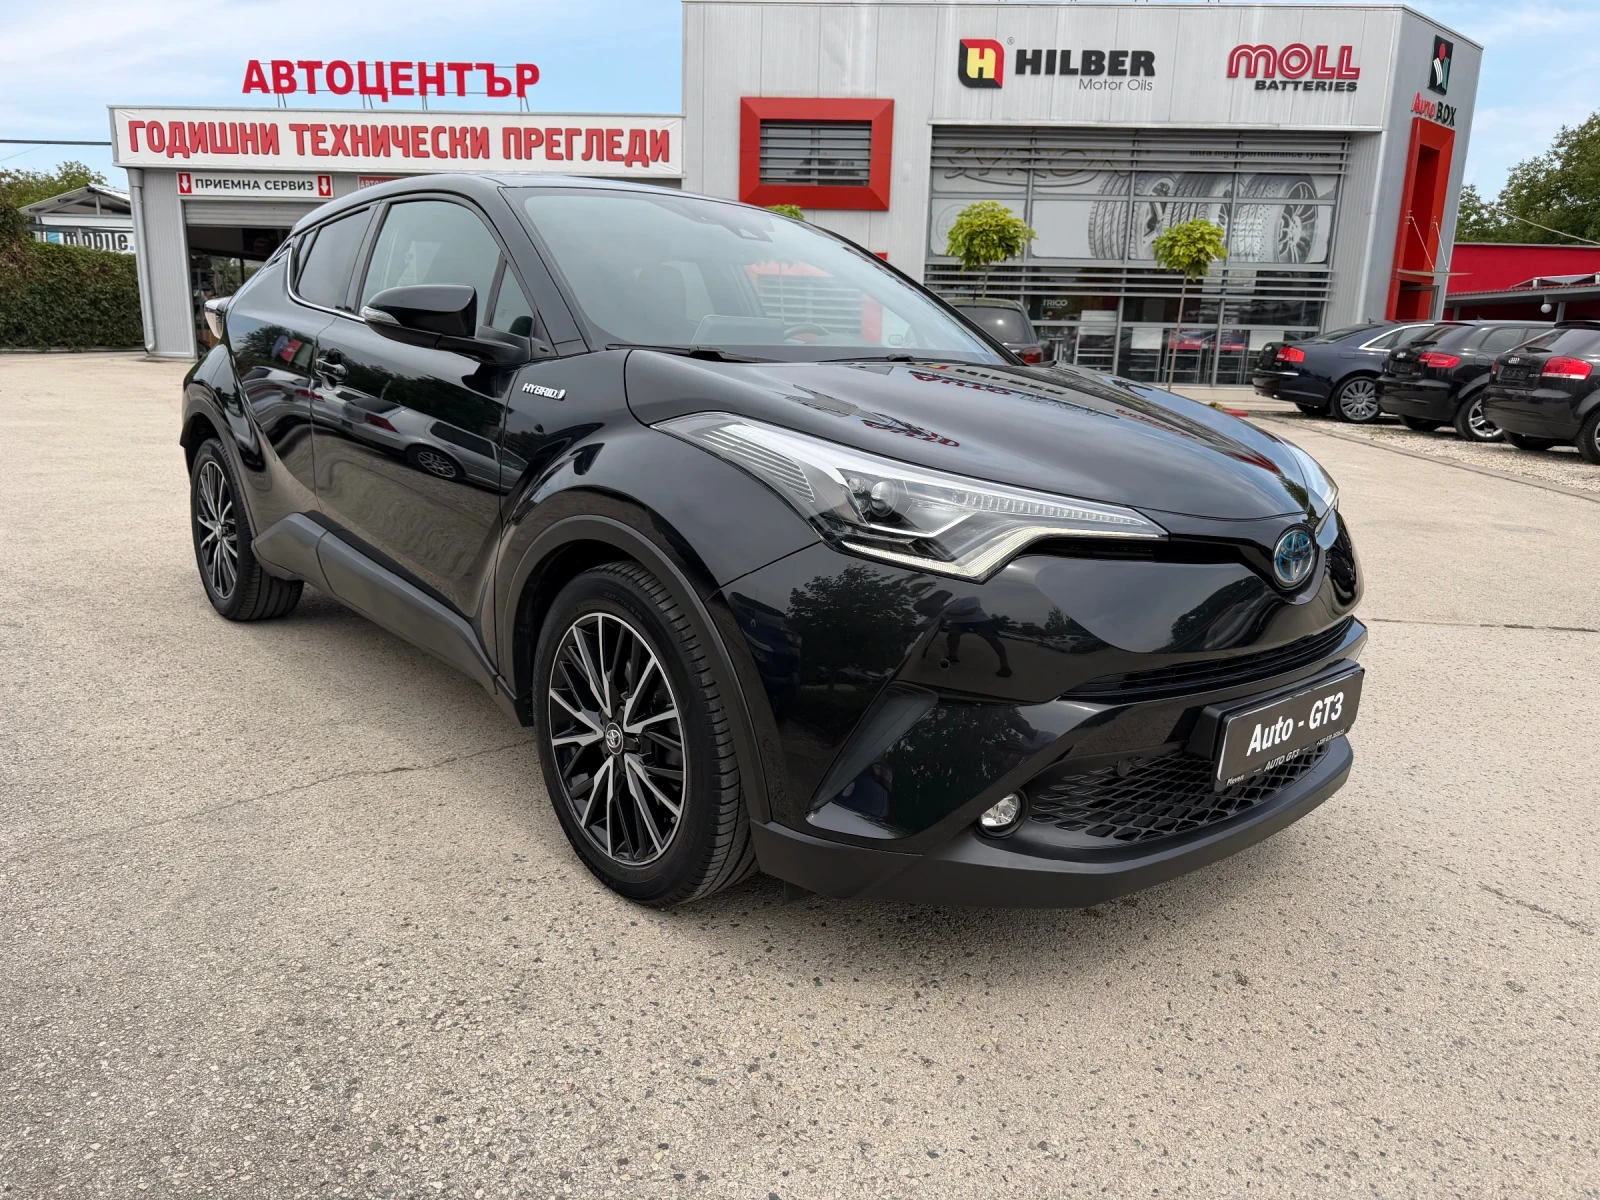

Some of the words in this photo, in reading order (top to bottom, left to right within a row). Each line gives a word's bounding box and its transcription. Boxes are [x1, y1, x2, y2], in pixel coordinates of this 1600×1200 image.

[1015, 49, 1155, 76] HILBER
[1227, 43, 1360, 79] MOLL
[242, 60, 540, 102] АВТОЦЕНТЪР
[1078, 79, 1123, 90] Motor
[1127, 79, 1153, 91] Oils
[1254, 80, 1358, 92] BATTERIES
[1435, 101, 1457, 127] BOX
[128, 120, 279, 158] ГОДИШНИ
[289, 123, 490, 160] ТЕХНИЧЕСКИ
[502, 127, 670, 167] ПРЕГЛЕДИ
[195, 178, 261, 191] ПРИЕМНА
[264, 180, 314, 191] СЕРВИЗ
[1043, 299, 1068, 307] TRICO
[522, 383, 557, 399] HYBRID
[1246, 716, 1294, 756] Auto
[1308, 692, 1344, 730] GT3
